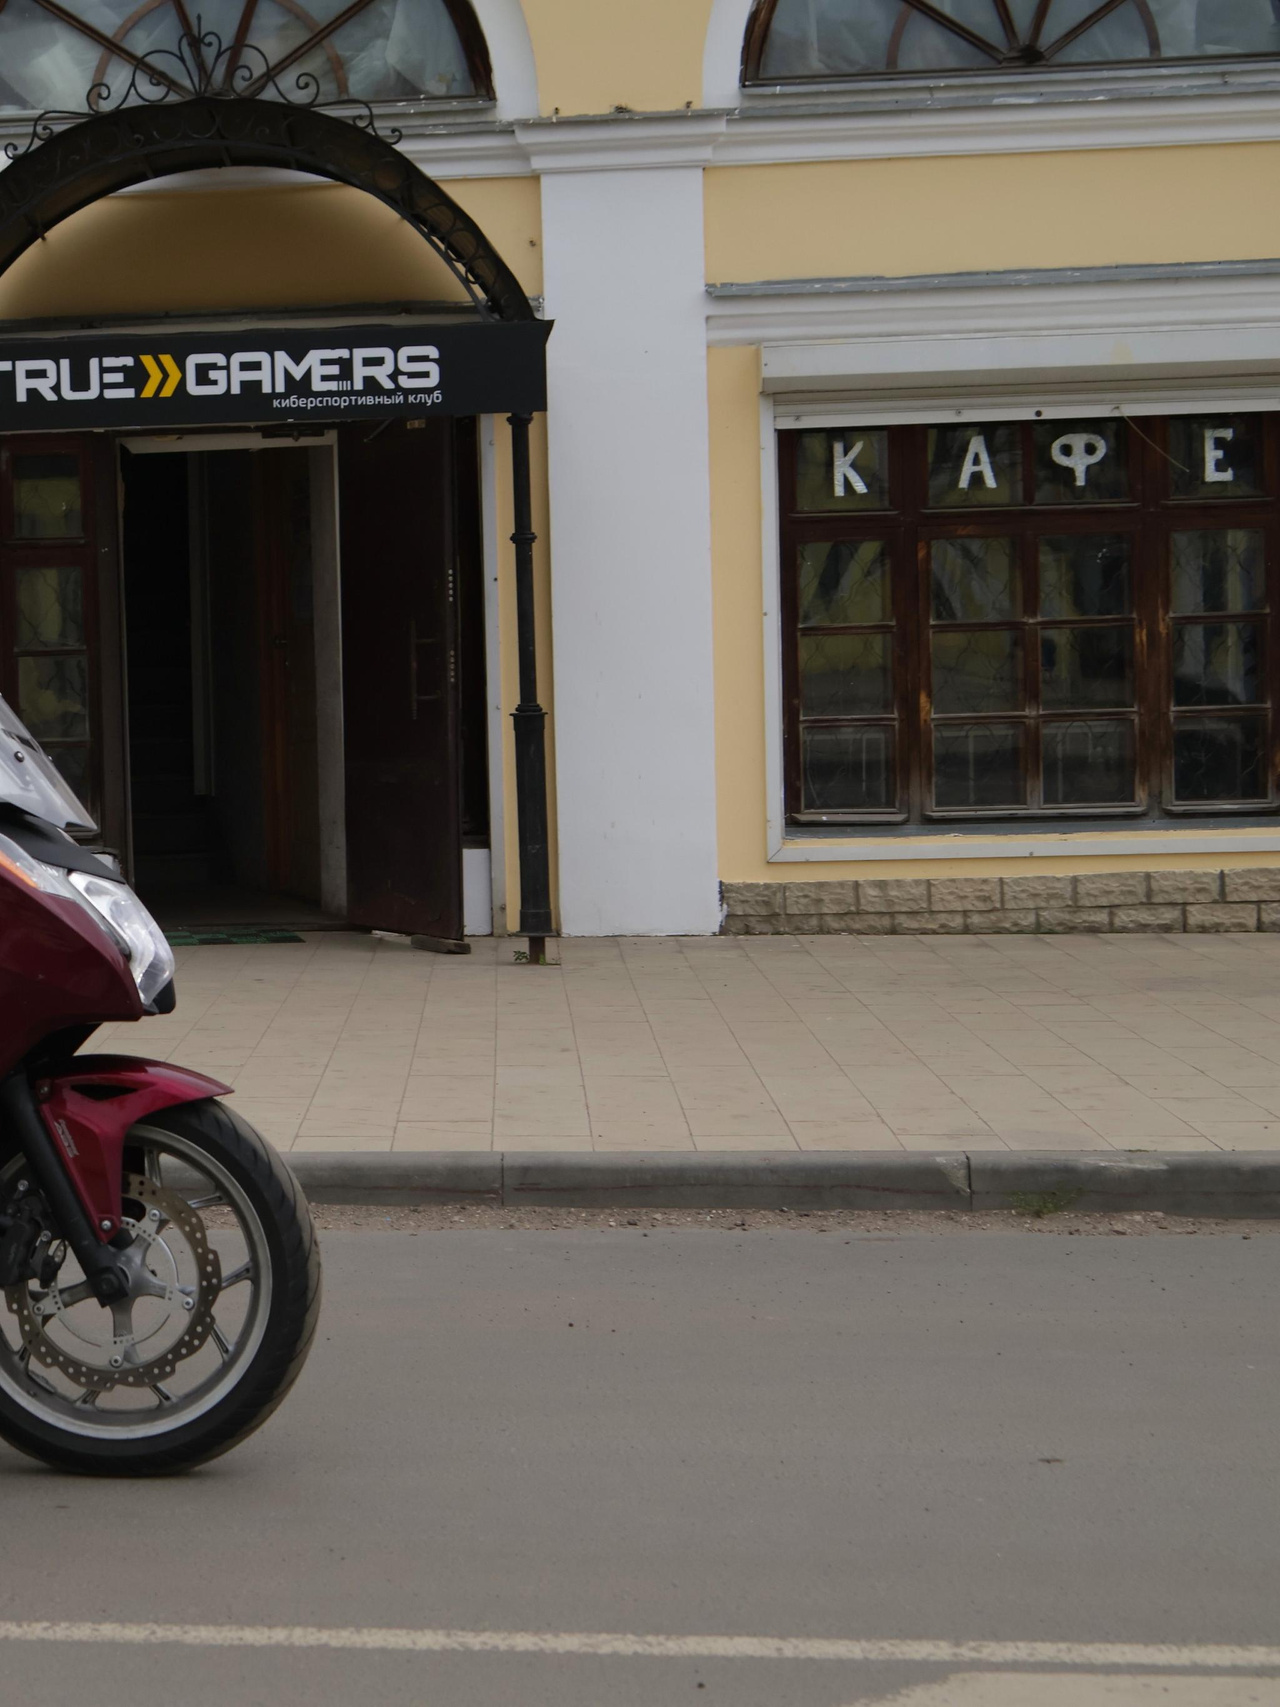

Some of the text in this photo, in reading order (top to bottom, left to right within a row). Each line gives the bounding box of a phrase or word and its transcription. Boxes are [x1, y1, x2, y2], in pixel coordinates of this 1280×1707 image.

[185, 345, 441, 397] GAMERS
[273, 390, 443, 410] киберспортивный клуб
[833, 428, 1234, 497] КАФЕ
